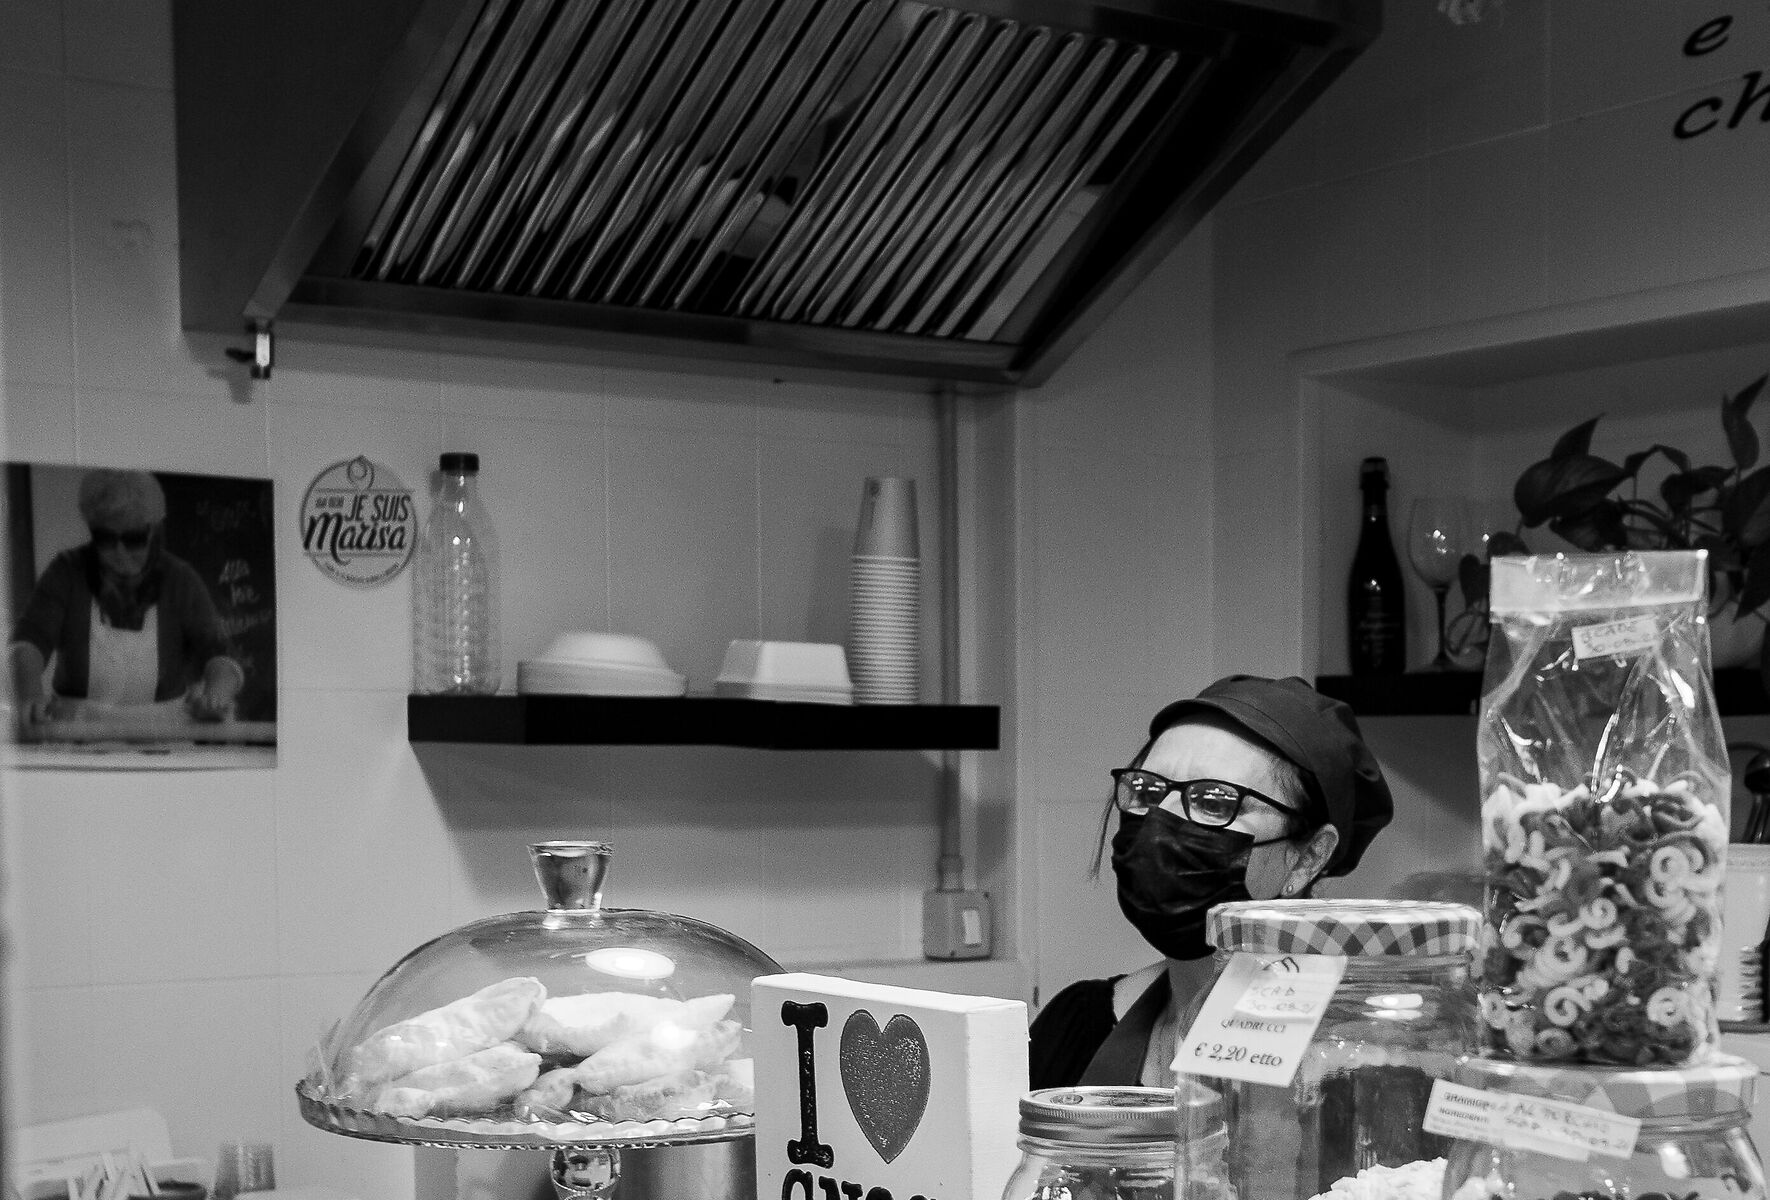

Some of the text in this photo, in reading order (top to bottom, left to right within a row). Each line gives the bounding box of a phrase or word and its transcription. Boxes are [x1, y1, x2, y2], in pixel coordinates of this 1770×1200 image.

[1683, 15, 1733, 57] e
[344, 494, 411, 522] JE SUIS
[303, 512, 406, 566] Marisa
[1194, 1042, 1282, 1067] € 2,20 etto
[781, 1000, 834, 1169] I
